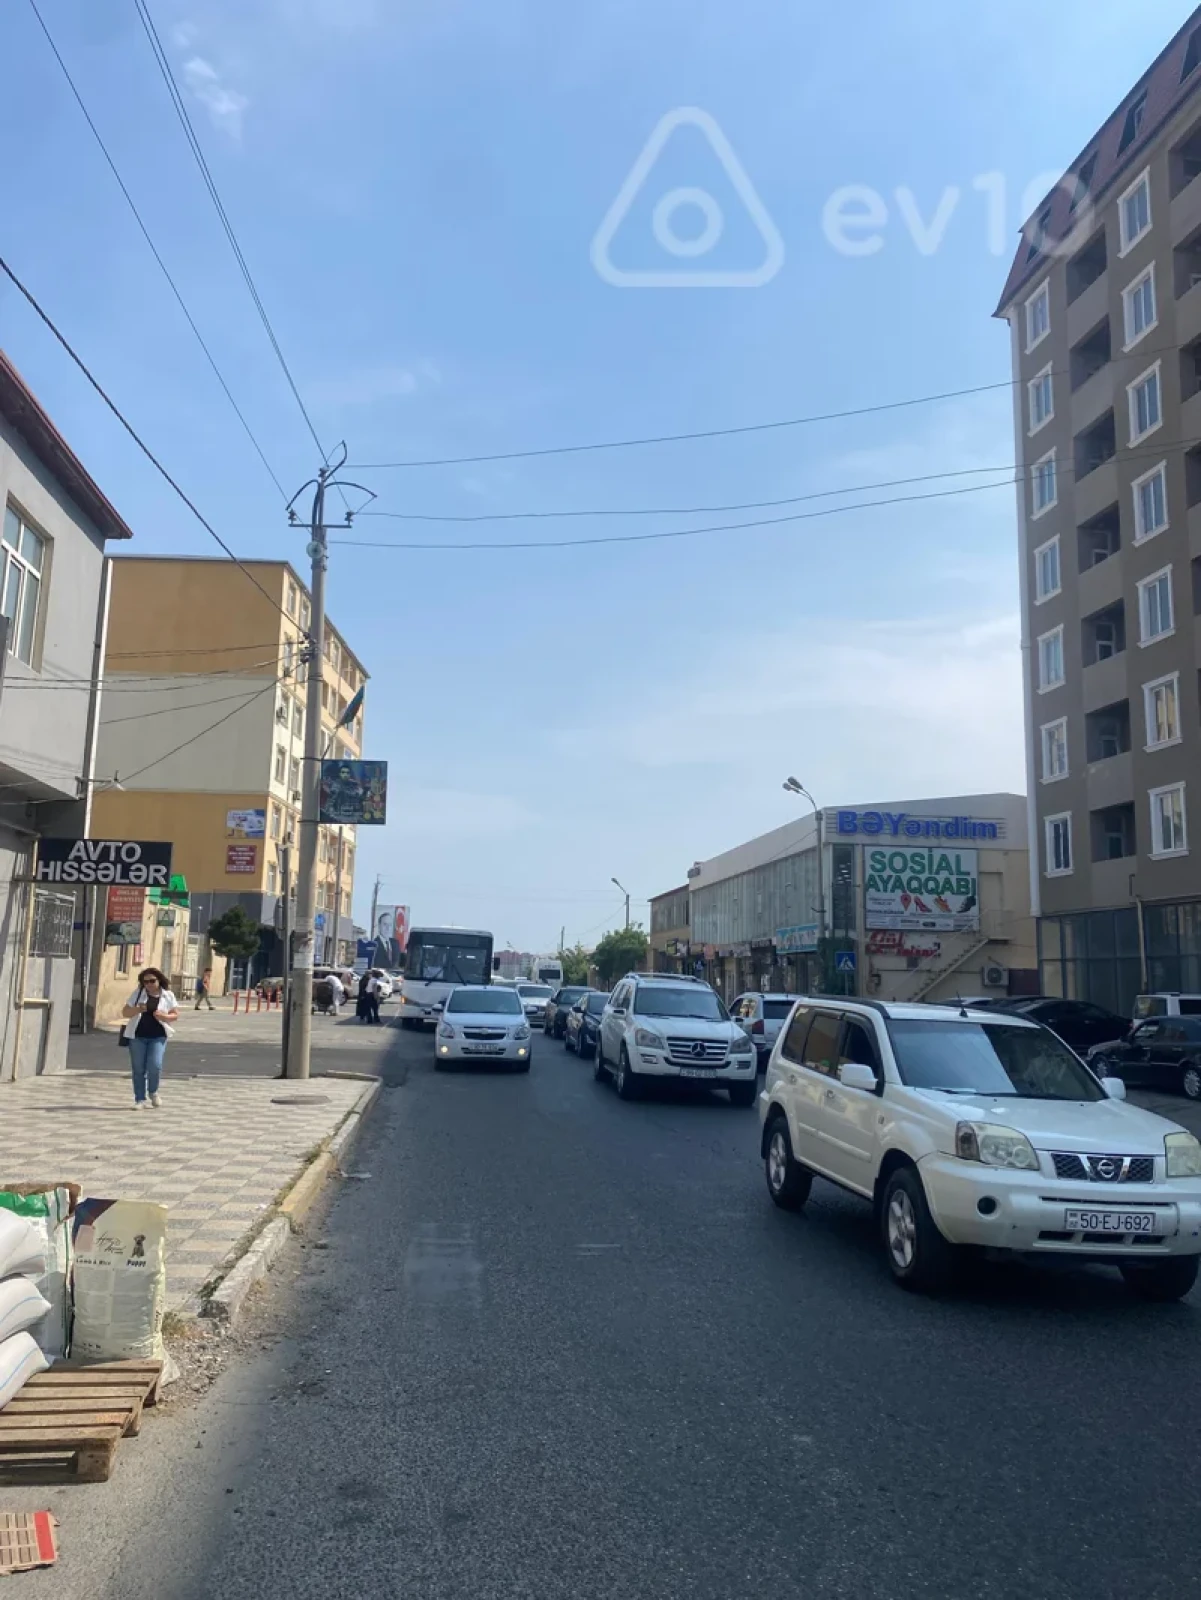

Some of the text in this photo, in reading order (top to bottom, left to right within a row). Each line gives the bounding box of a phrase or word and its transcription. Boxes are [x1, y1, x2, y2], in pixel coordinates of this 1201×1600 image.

[68, 840, 142, 863] AVTO
[869, 848, 971, 875] SOSİAL
[36, 860, 168, 885] HISSƏLƏR
[866, 873, 977, 896] AYAQQABI
